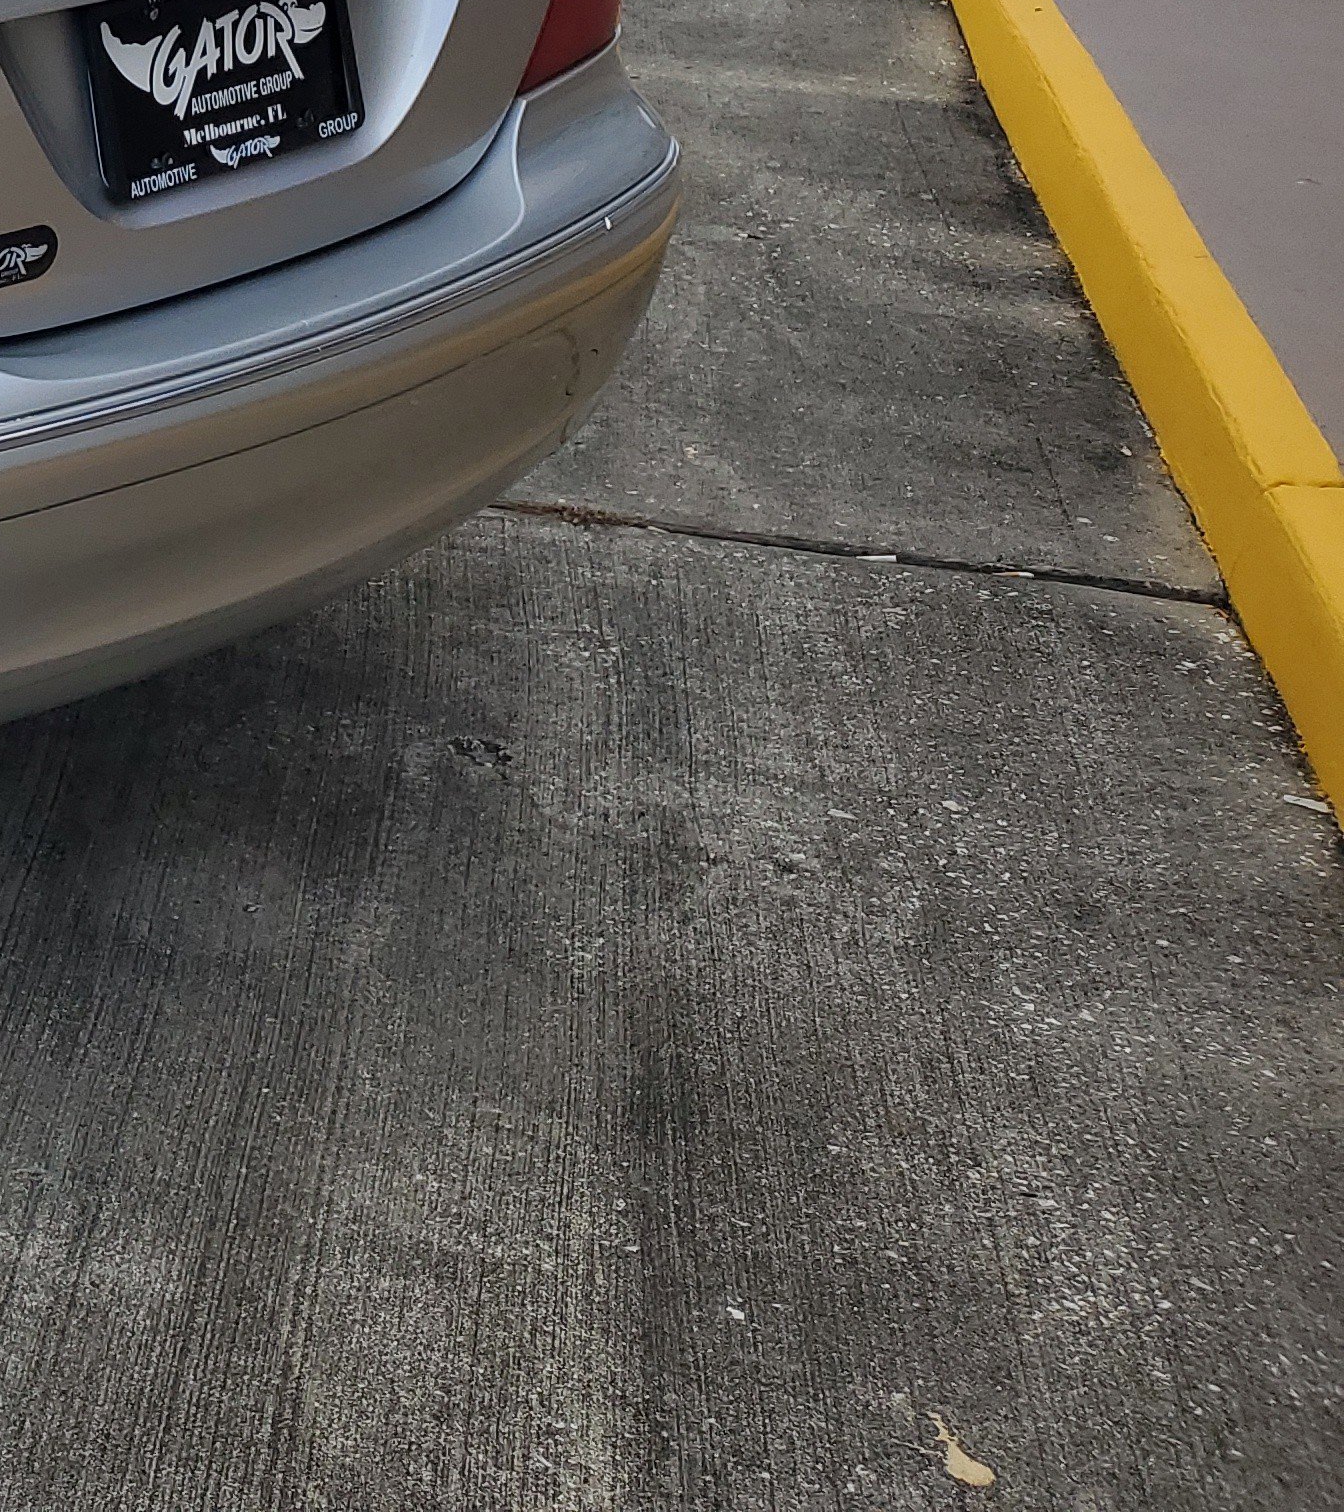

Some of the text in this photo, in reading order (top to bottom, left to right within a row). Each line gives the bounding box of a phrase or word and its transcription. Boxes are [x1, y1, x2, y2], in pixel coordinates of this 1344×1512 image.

[152, 1, 305, 121] GATOR
[191, 70, 294, 116] AUTOMOTIVE GROUP
[267, 103, 287, 124] FL
[318, 112, 359, 139] GROUP
[226, 136, 273, 170] GATOR
[130, 163, 198, 199] AUTOMOTIVE
